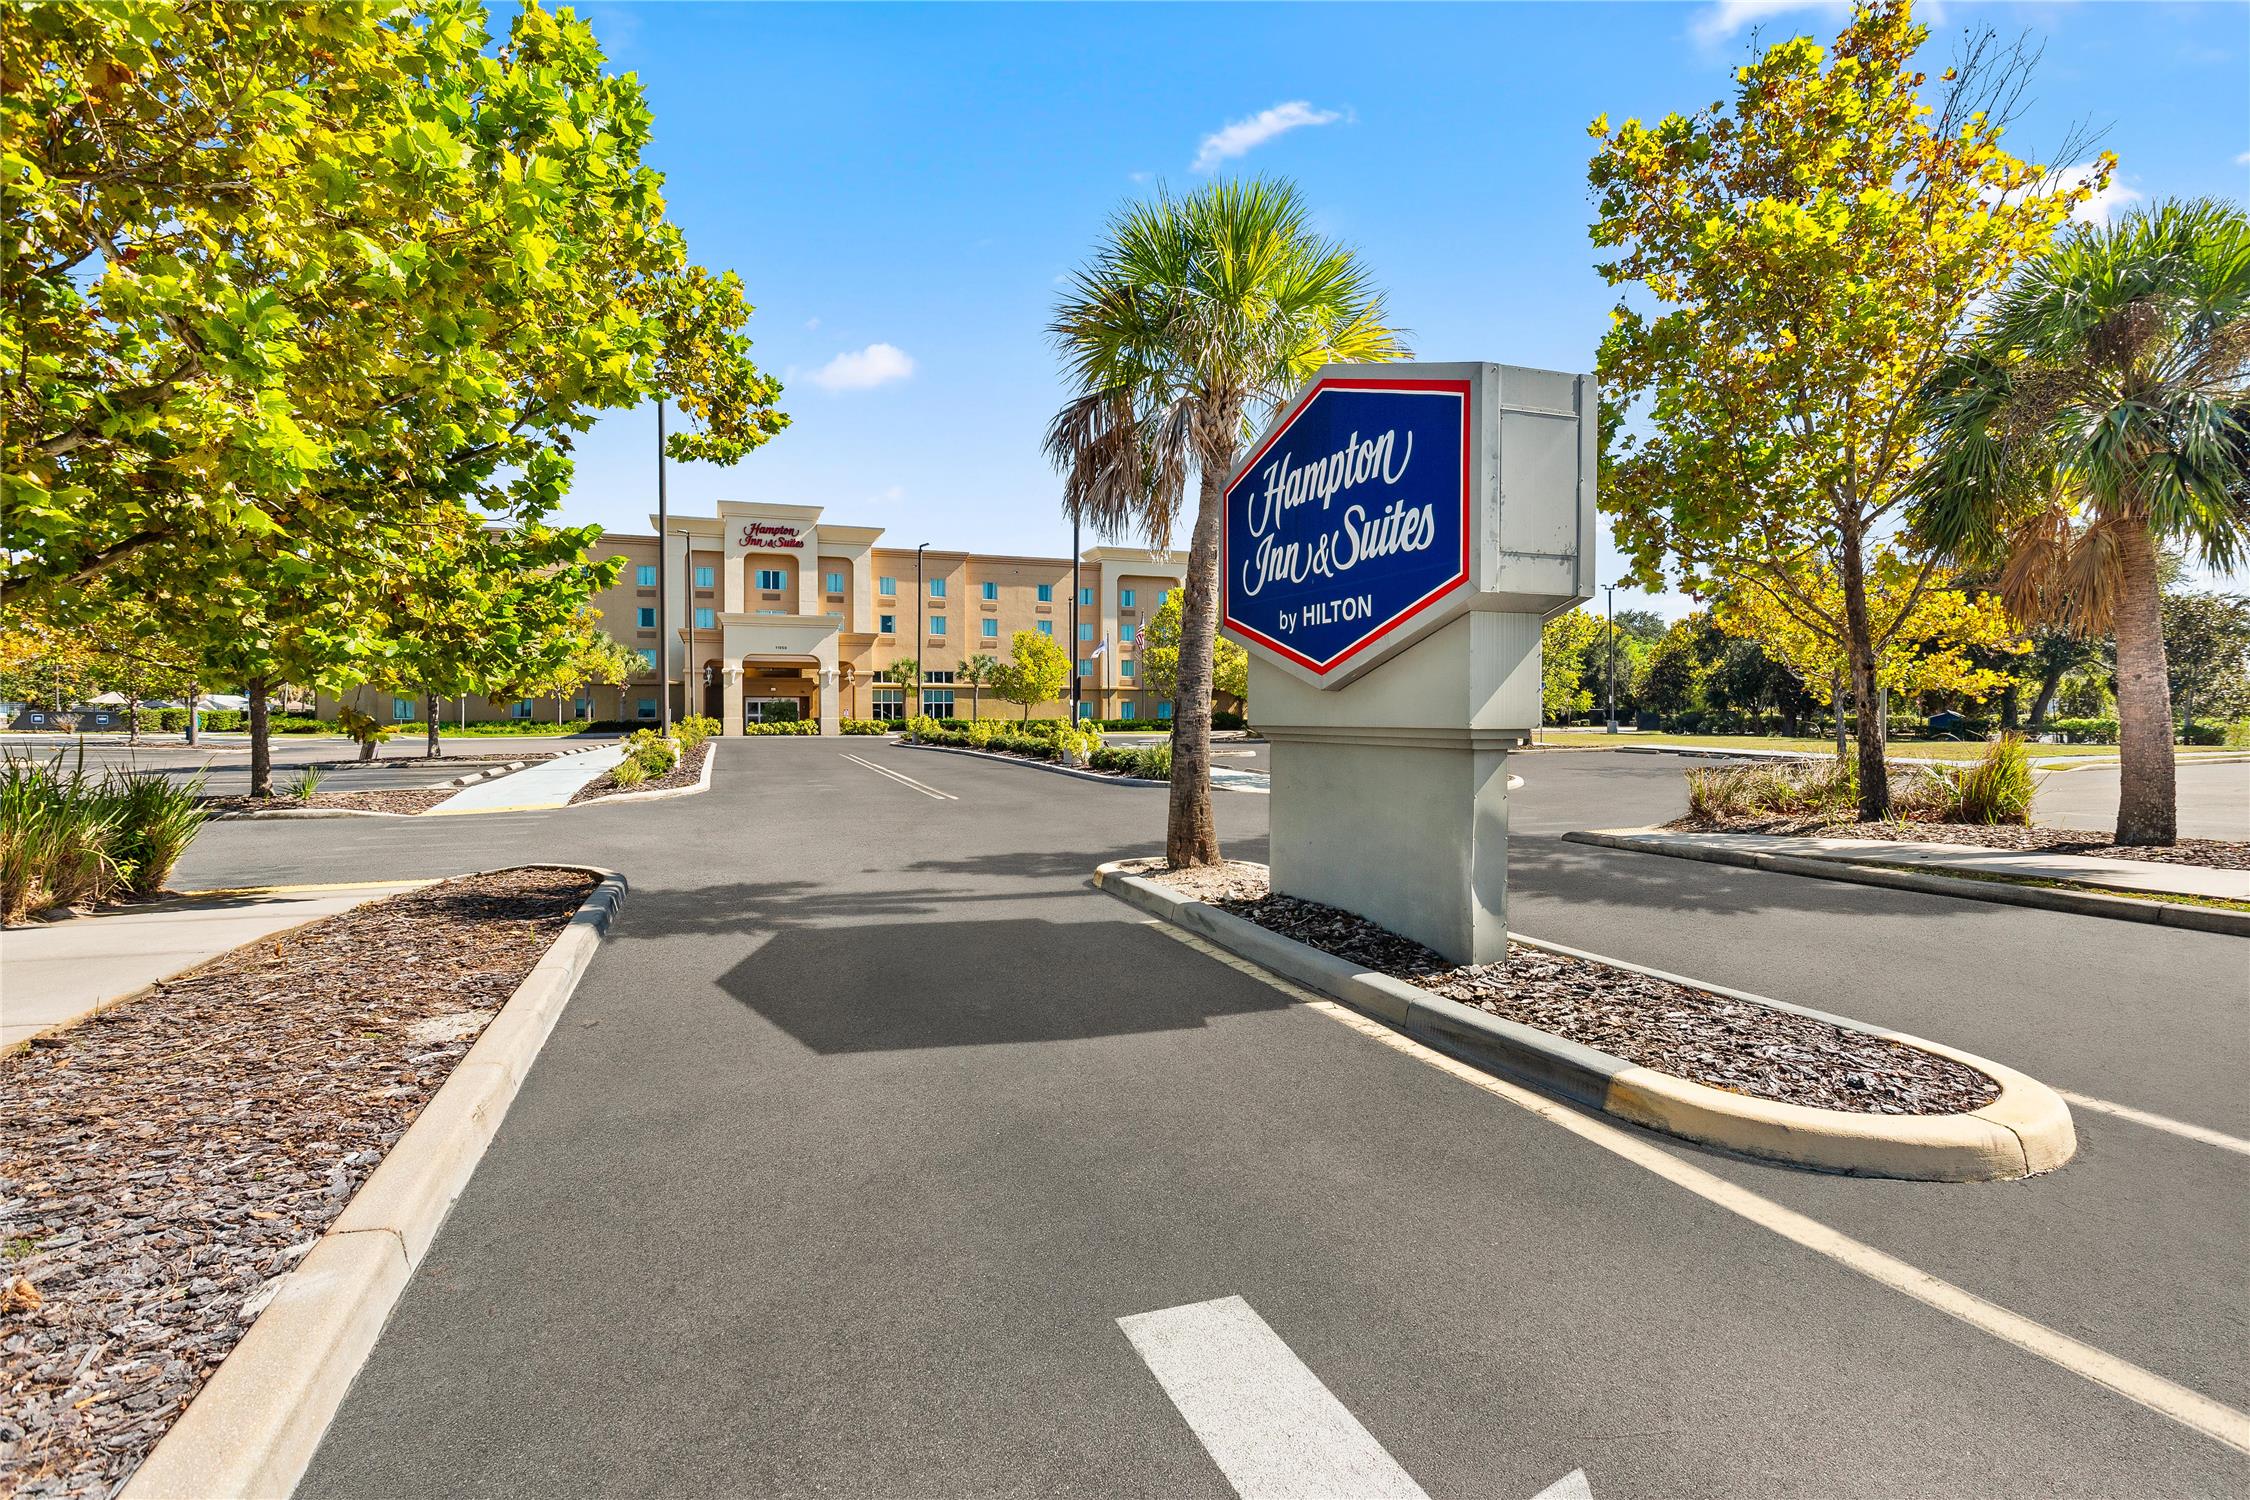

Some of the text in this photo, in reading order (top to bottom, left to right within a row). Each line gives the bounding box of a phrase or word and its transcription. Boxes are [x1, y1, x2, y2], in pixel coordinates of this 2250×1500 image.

[1248, 430, 1412, 538] Hampton
[739, 536, 767, 548] Inn
[774, 536, 805, 548] Suites
[743, 522, 800, 537] Hampton
[1243, 499, 1435, 596] Inn & Suites
[1280, 594, 1372, 634] by HILTON
